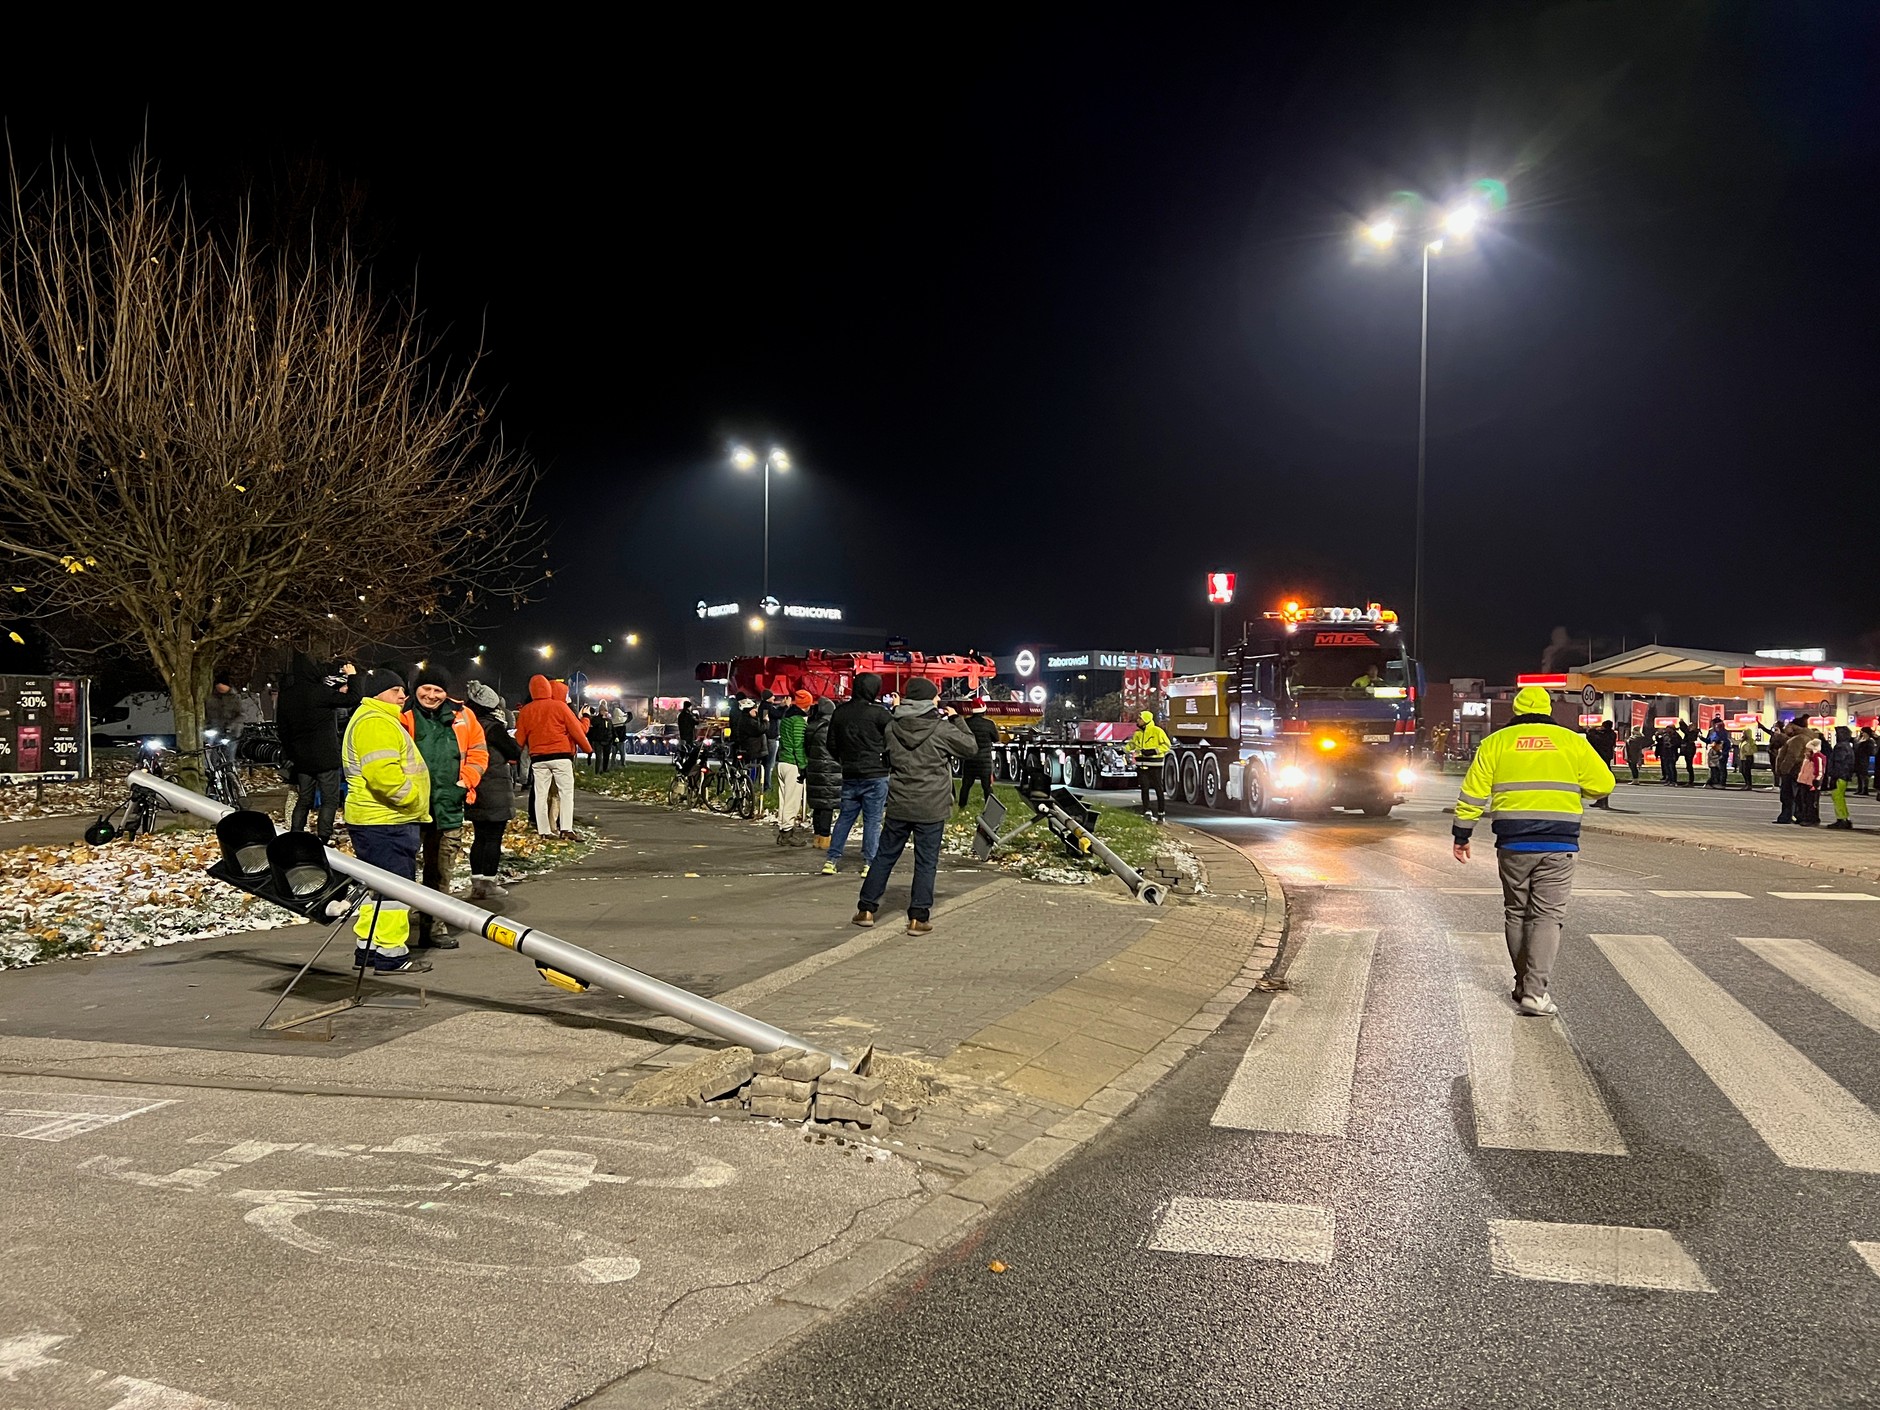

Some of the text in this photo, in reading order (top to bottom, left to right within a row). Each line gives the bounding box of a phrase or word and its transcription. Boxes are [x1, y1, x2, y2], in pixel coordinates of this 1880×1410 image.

[783, 606, 842, 620] MEDICOVER
[1100, 654, 1164, 669] NISSAN
[16, 696, 47, 708] -30%
[1584, 690, 1594, 701] 60
[49, 742, 78, 754] -30%
[1515, 736, 1545, 750] MTD
